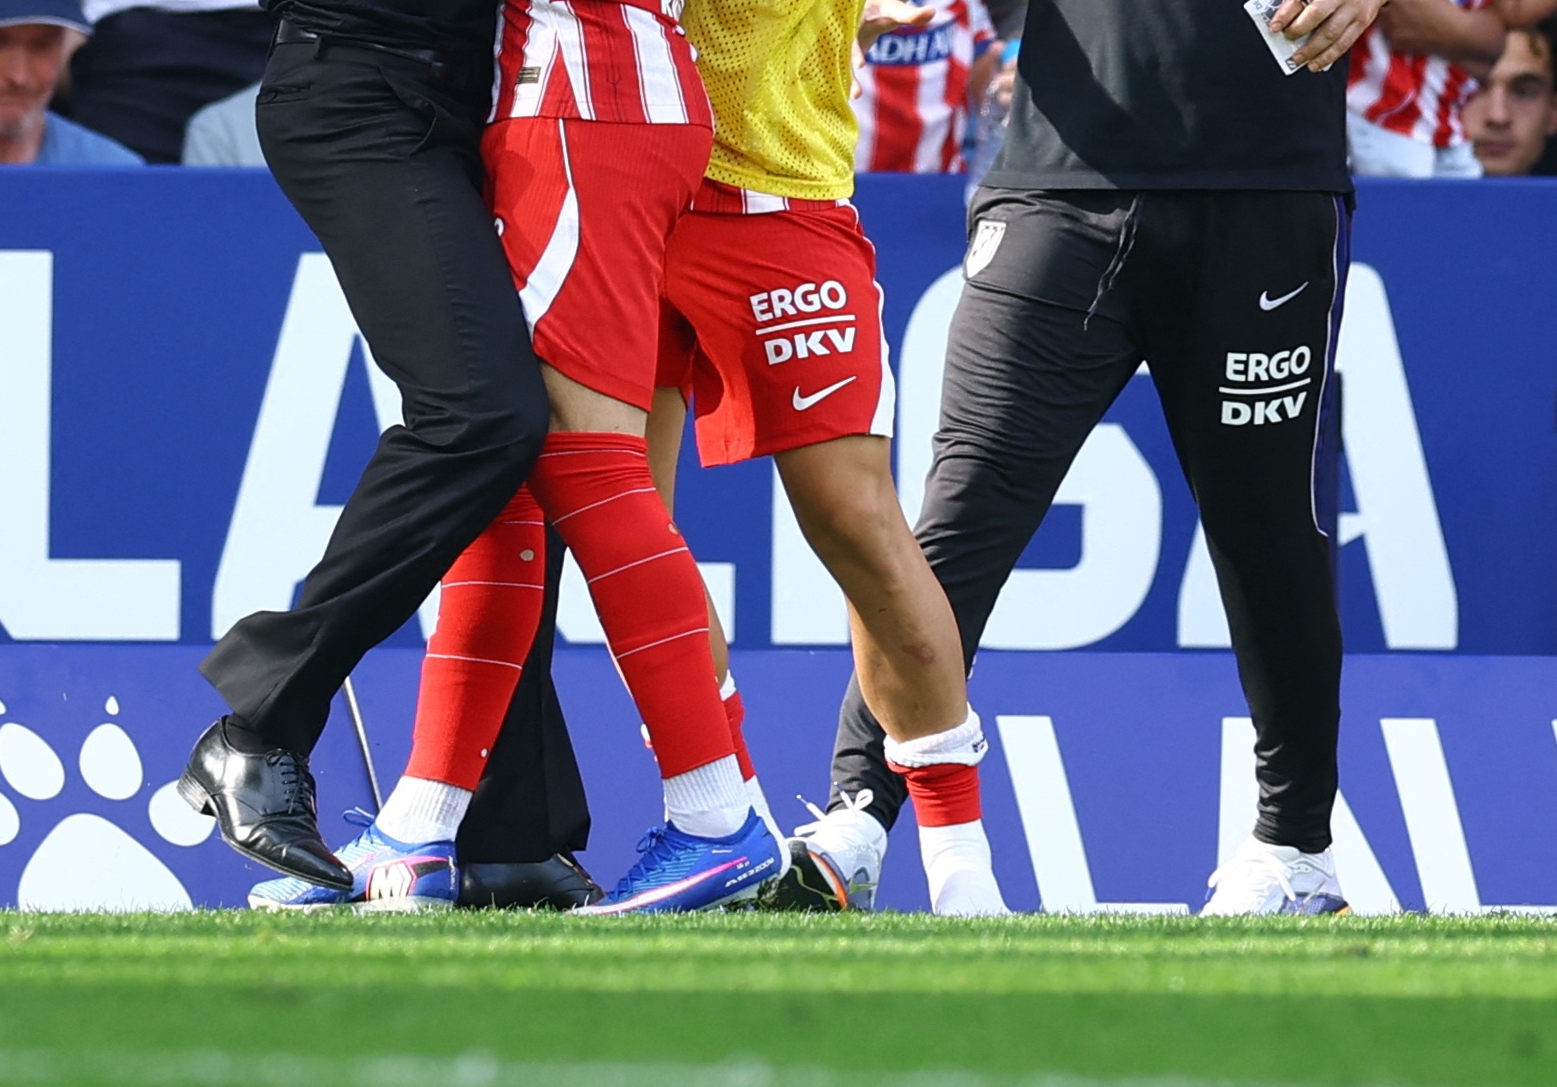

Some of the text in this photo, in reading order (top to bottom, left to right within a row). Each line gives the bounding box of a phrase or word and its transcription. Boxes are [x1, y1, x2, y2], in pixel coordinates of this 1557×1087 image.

[749, 280, 847, 323] ERGO
[764, 327, 856, 366] DKV
[1225, 345, 1311, 382] ERGO
[1221, 391, 1307, 426] DKV
